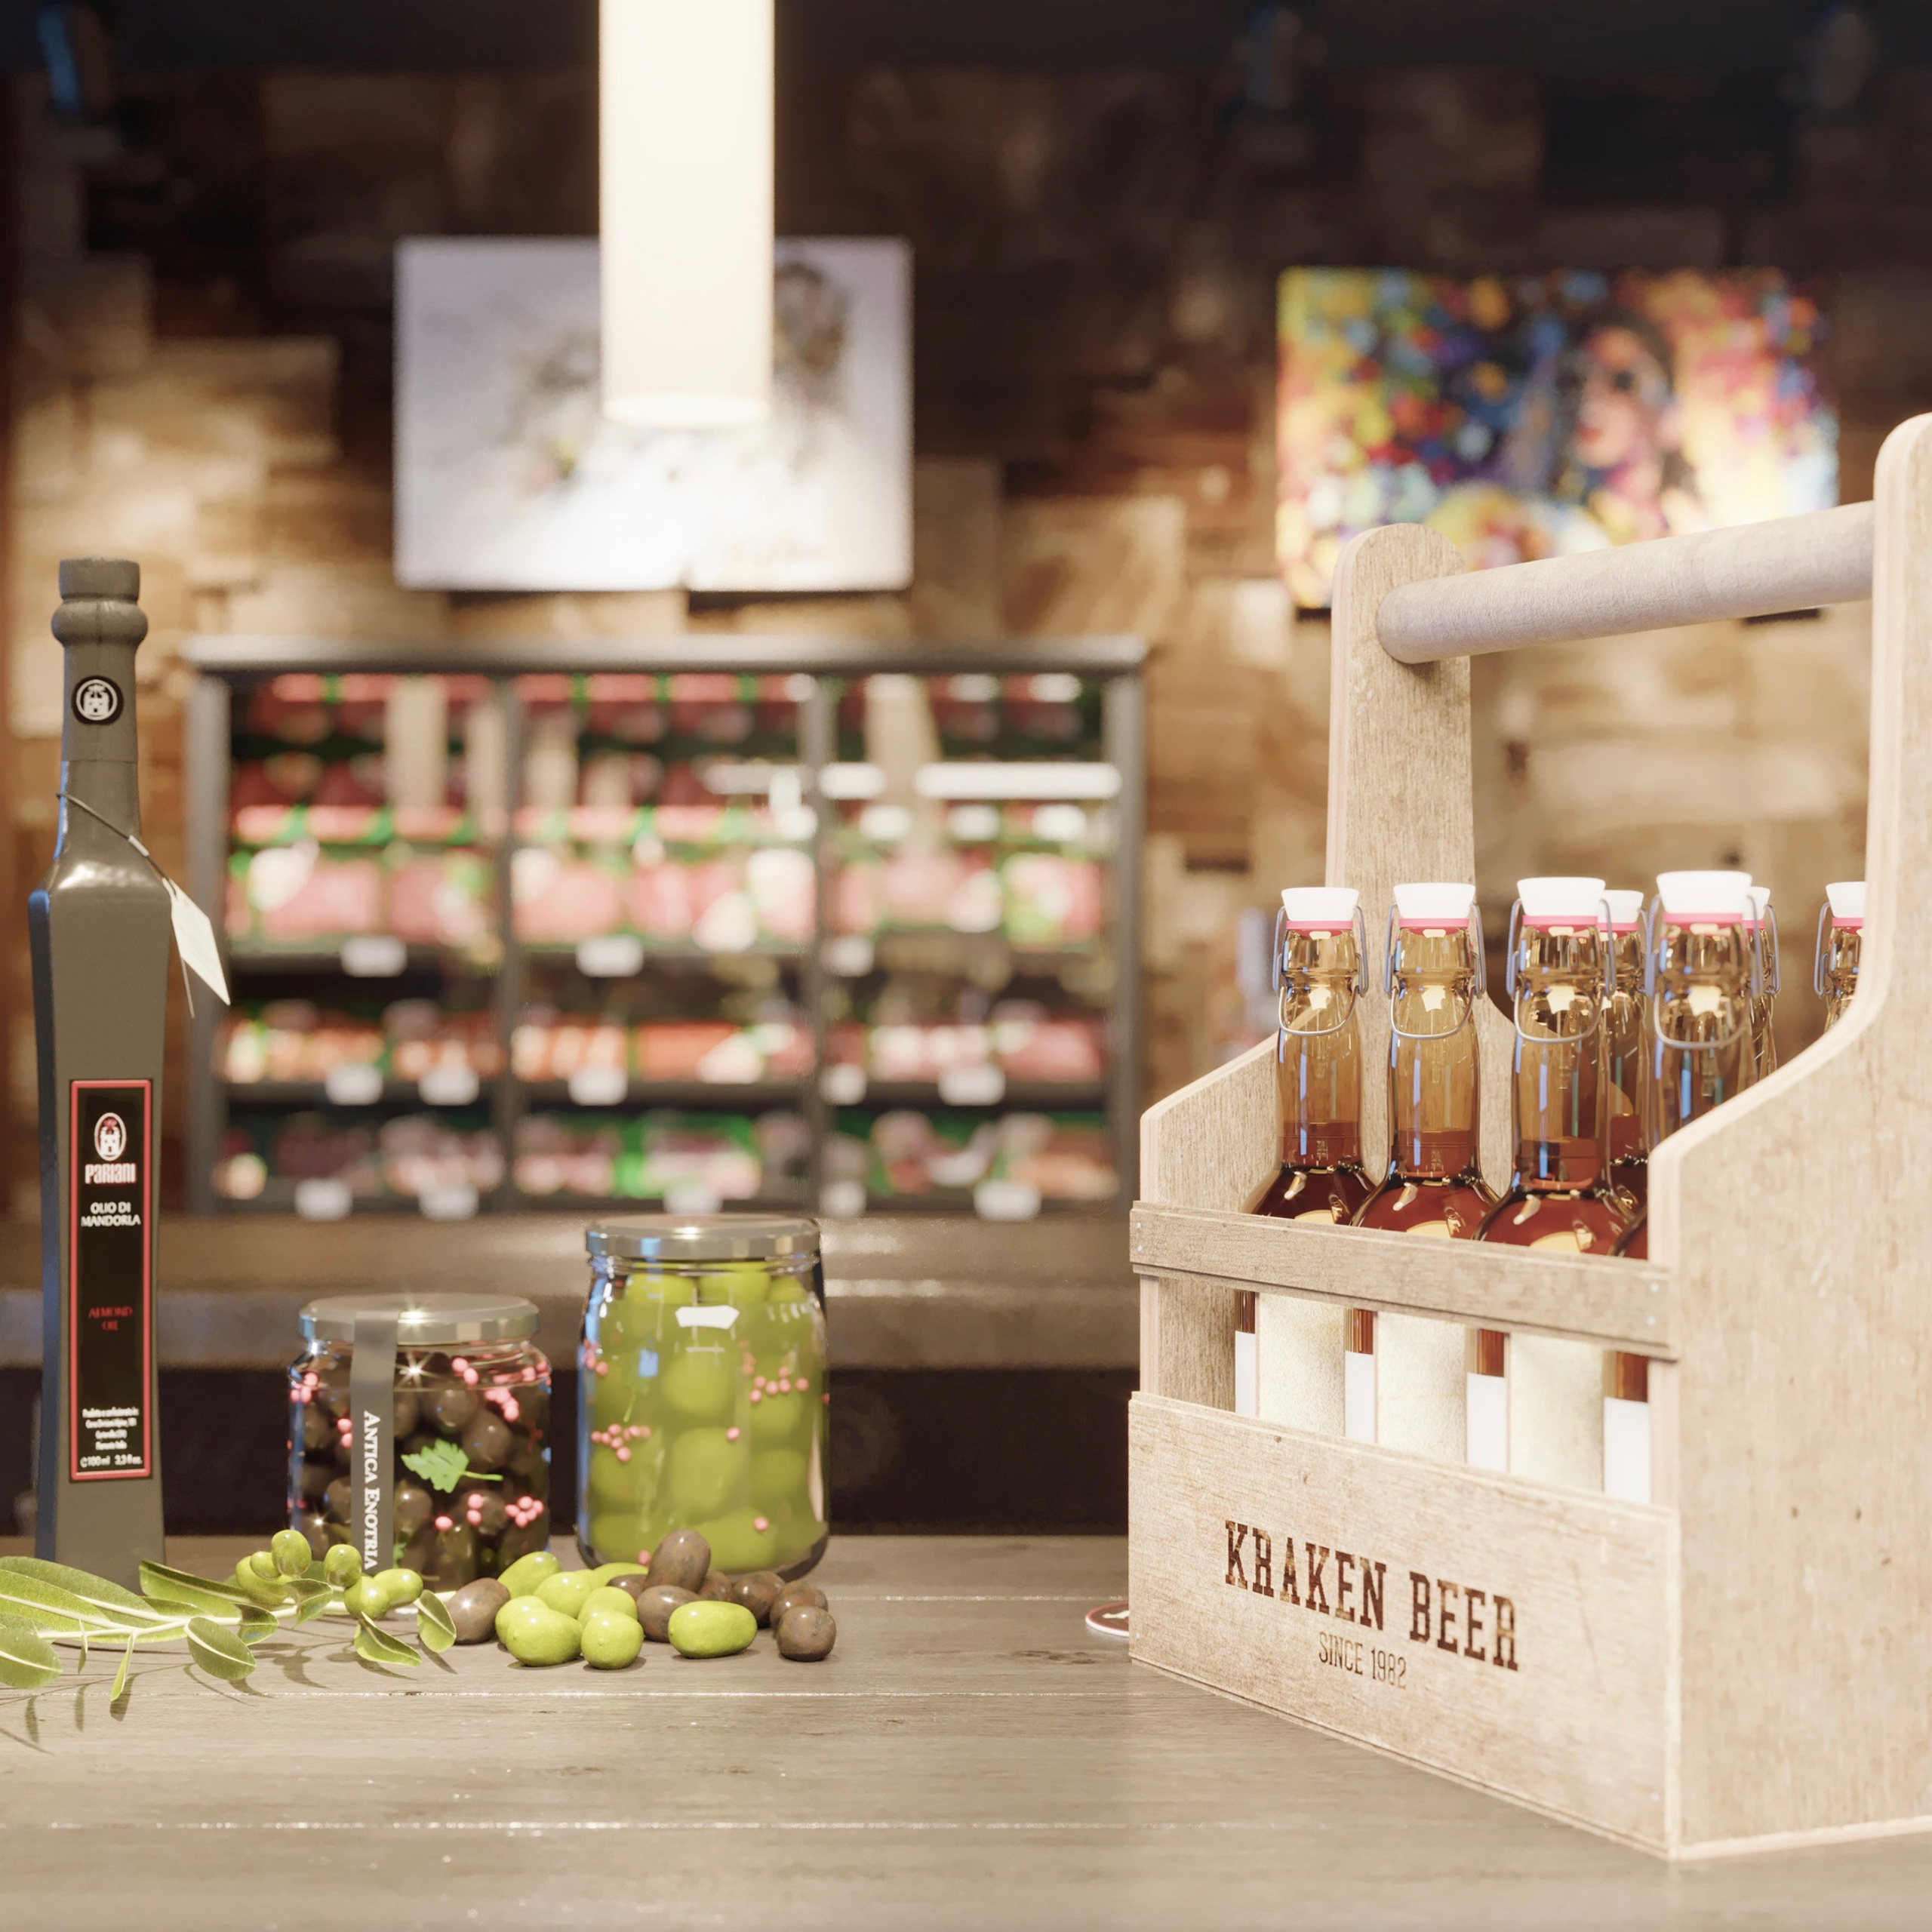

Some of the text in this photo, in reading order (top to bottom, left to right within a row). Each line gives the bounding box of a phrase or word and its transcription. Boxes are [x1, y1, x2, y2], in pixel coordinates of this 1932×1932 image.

[80, 1214, 141, 1227] MANDORLA
[90, 1201, 131, 1214] OLIO DI
[364, 1410, 381, 1570] ANTICA ENOTRIA
[1225, 1519, 1518, 1672] KRAKEN BEER
[1318, 1632, 1407, 1690] SINCE 1982
